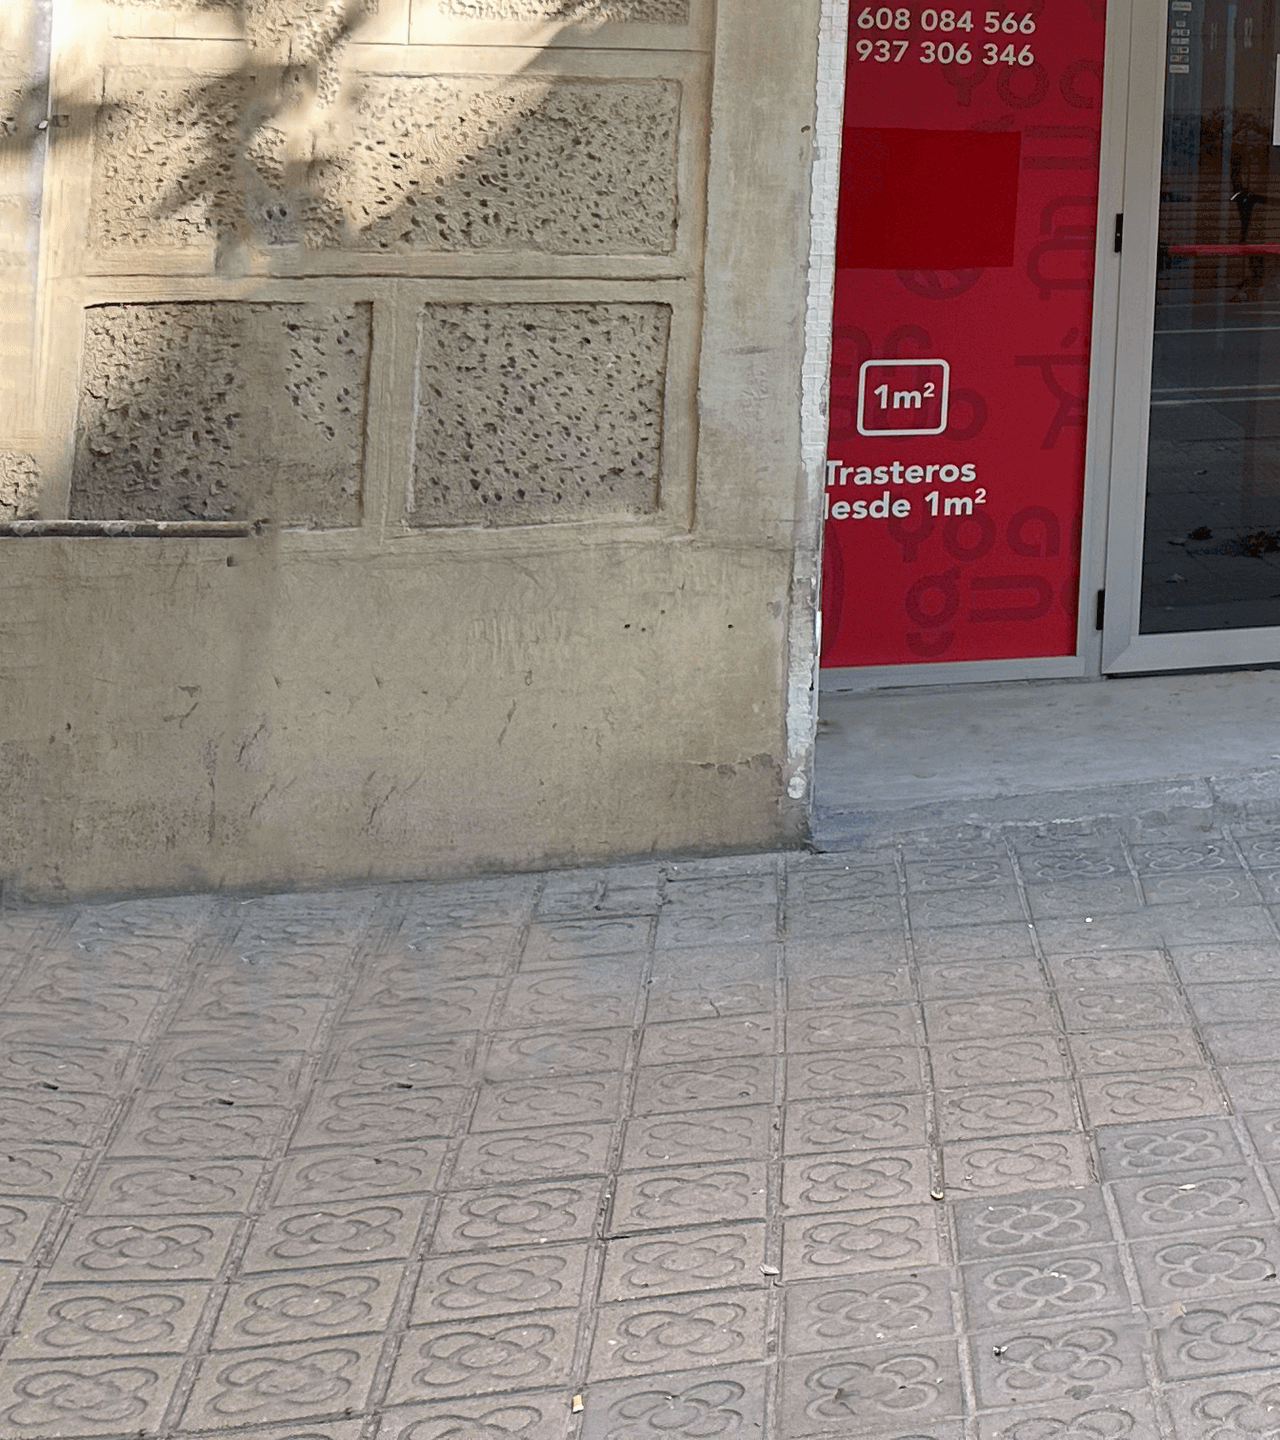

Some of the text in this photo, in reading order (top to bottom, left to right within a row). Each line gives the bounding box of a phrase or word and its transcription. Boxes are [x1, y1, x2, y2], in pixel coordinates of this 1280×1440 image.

[858, 8, 1035, 34] 608 084 566
[856, 40, 1034, 65] 937 306 346
[827, 460, 977, 486] Trasteros
